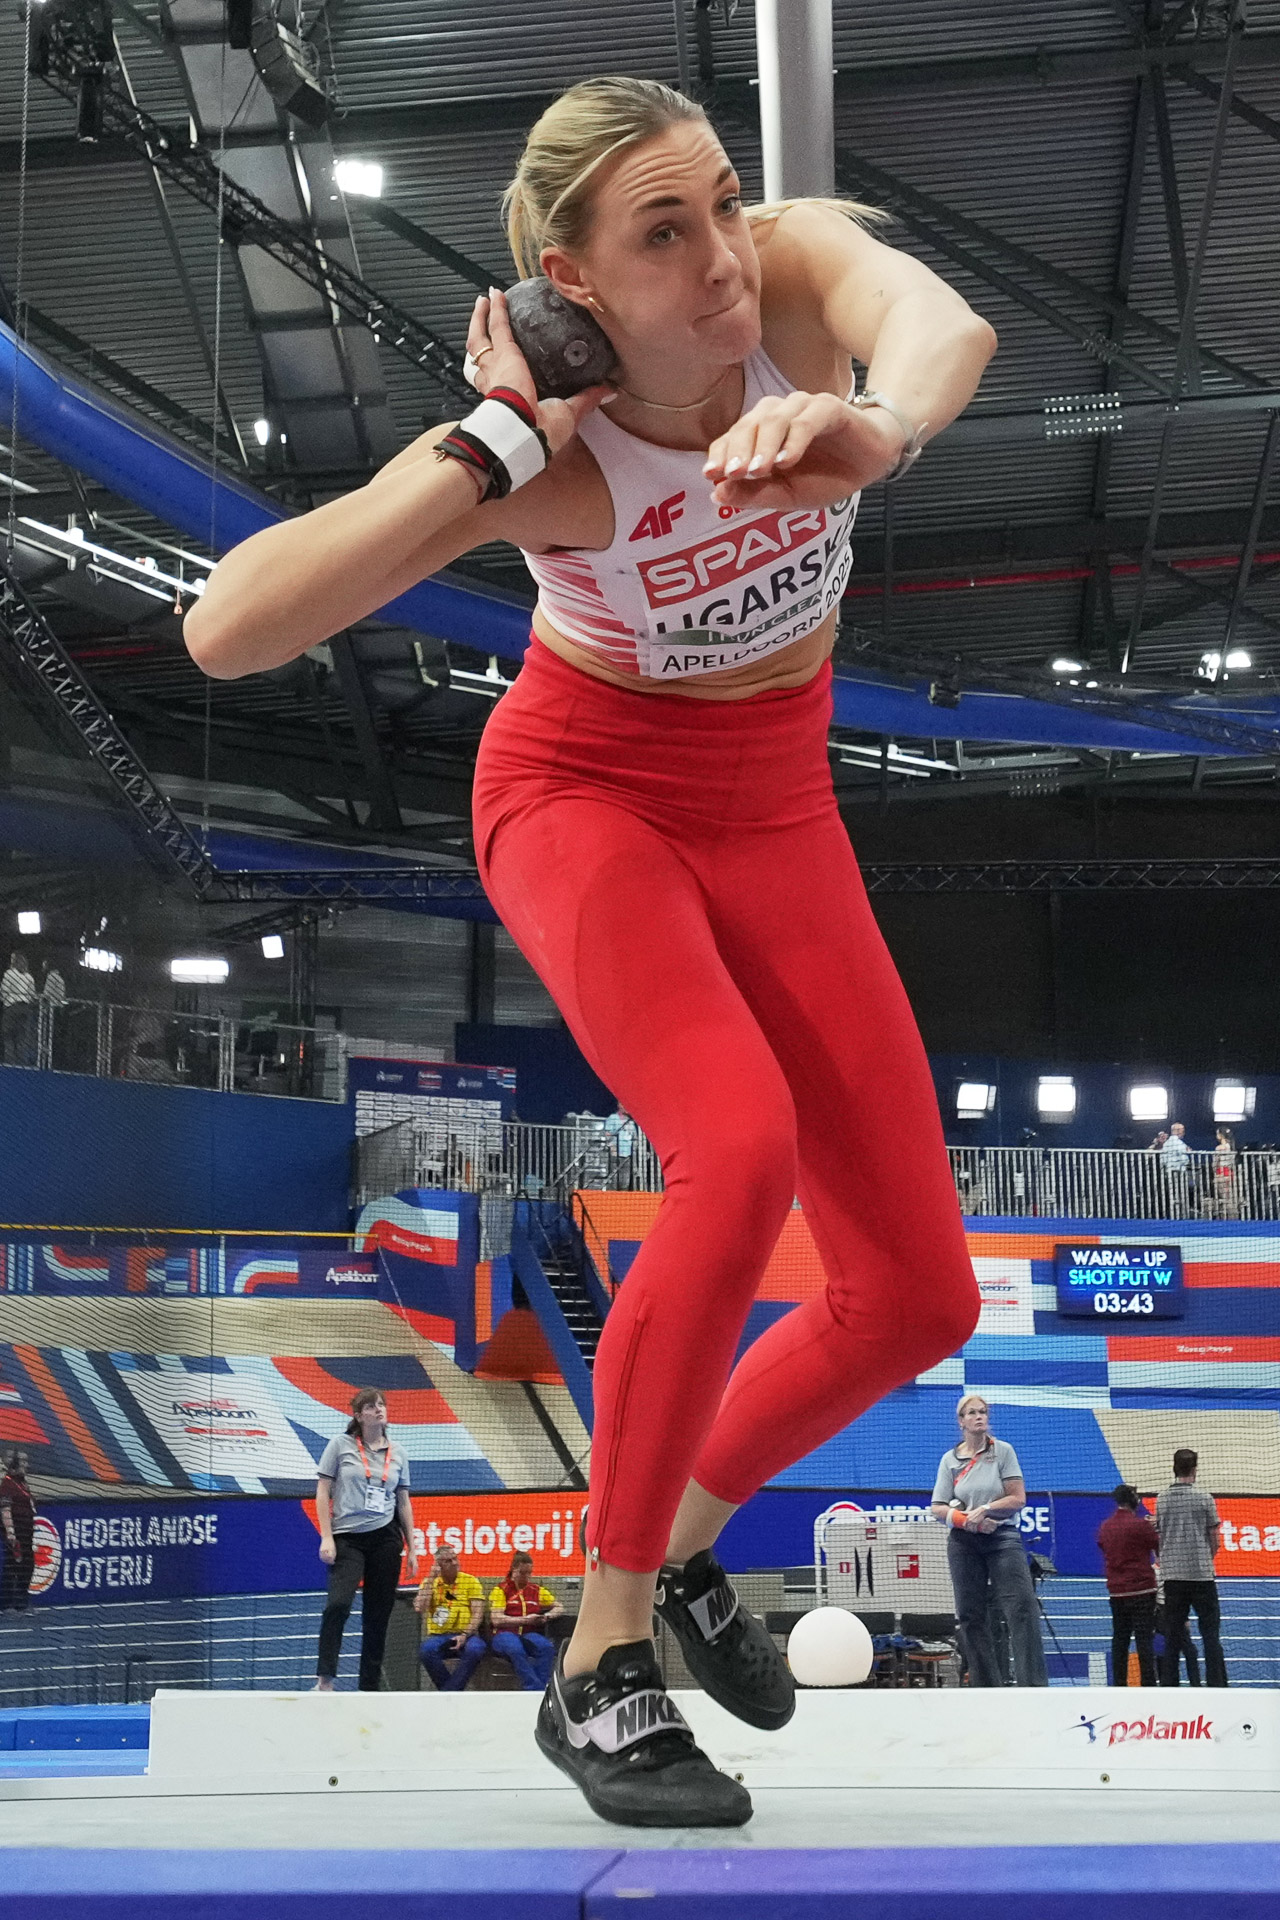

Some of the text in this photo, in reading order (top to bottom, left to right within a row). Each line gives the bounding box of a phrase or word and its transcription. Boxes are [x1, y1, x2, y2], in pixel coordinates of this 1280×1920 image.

[646, 509, 822, 599] SPAR
[656, 505, 855, 634] GARSKA
[662, 549, 851, 673] APELDOORN 2025
[769, 593, 822, 627] CLEA
[1070, 1250, 1130, 1266] WARM
[1143, 1250, 1168, 1267] UP
[1068, 1269, 1173, 1286] SHOT PUT W
[1093, 1292, 1154, 1314] 03:43
[64, 1514, 219, 1550] NEDERLANDSE
[412, 1510, 574, 1558] atsloterij
[63, 1554, 153, 1589] LOTERIJ
[1107, 1714, 1213, 1749] polanik
